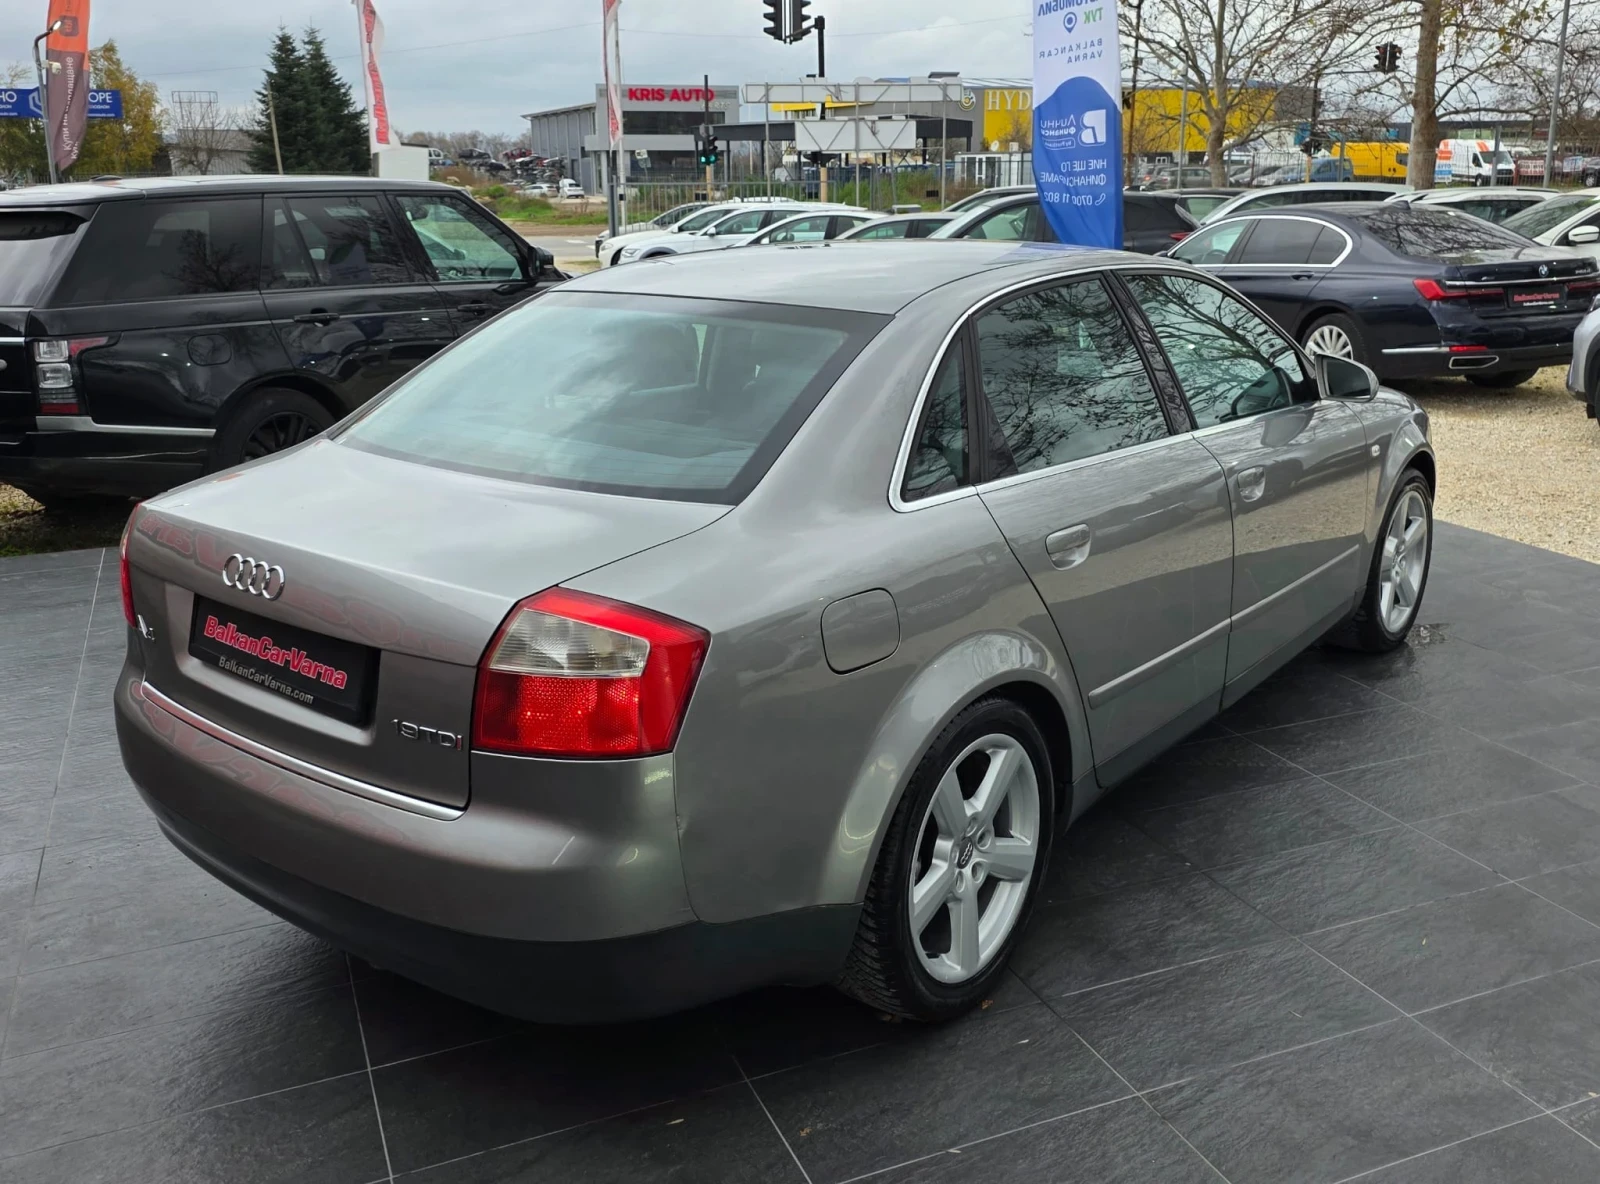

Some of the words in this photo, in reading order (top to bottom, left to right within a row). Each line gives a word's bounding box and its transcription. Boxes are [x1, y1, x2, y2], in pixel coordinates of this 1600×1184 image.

[628, 88, 665, 101] KRIS
[669, 88, 714, 102] AUTO
[988, 90, 1032, 110] HYD
[204, 615, 348, 689] BalkanCarVarna
[218, 655, 314, 705] BalkanCarVarna.com
